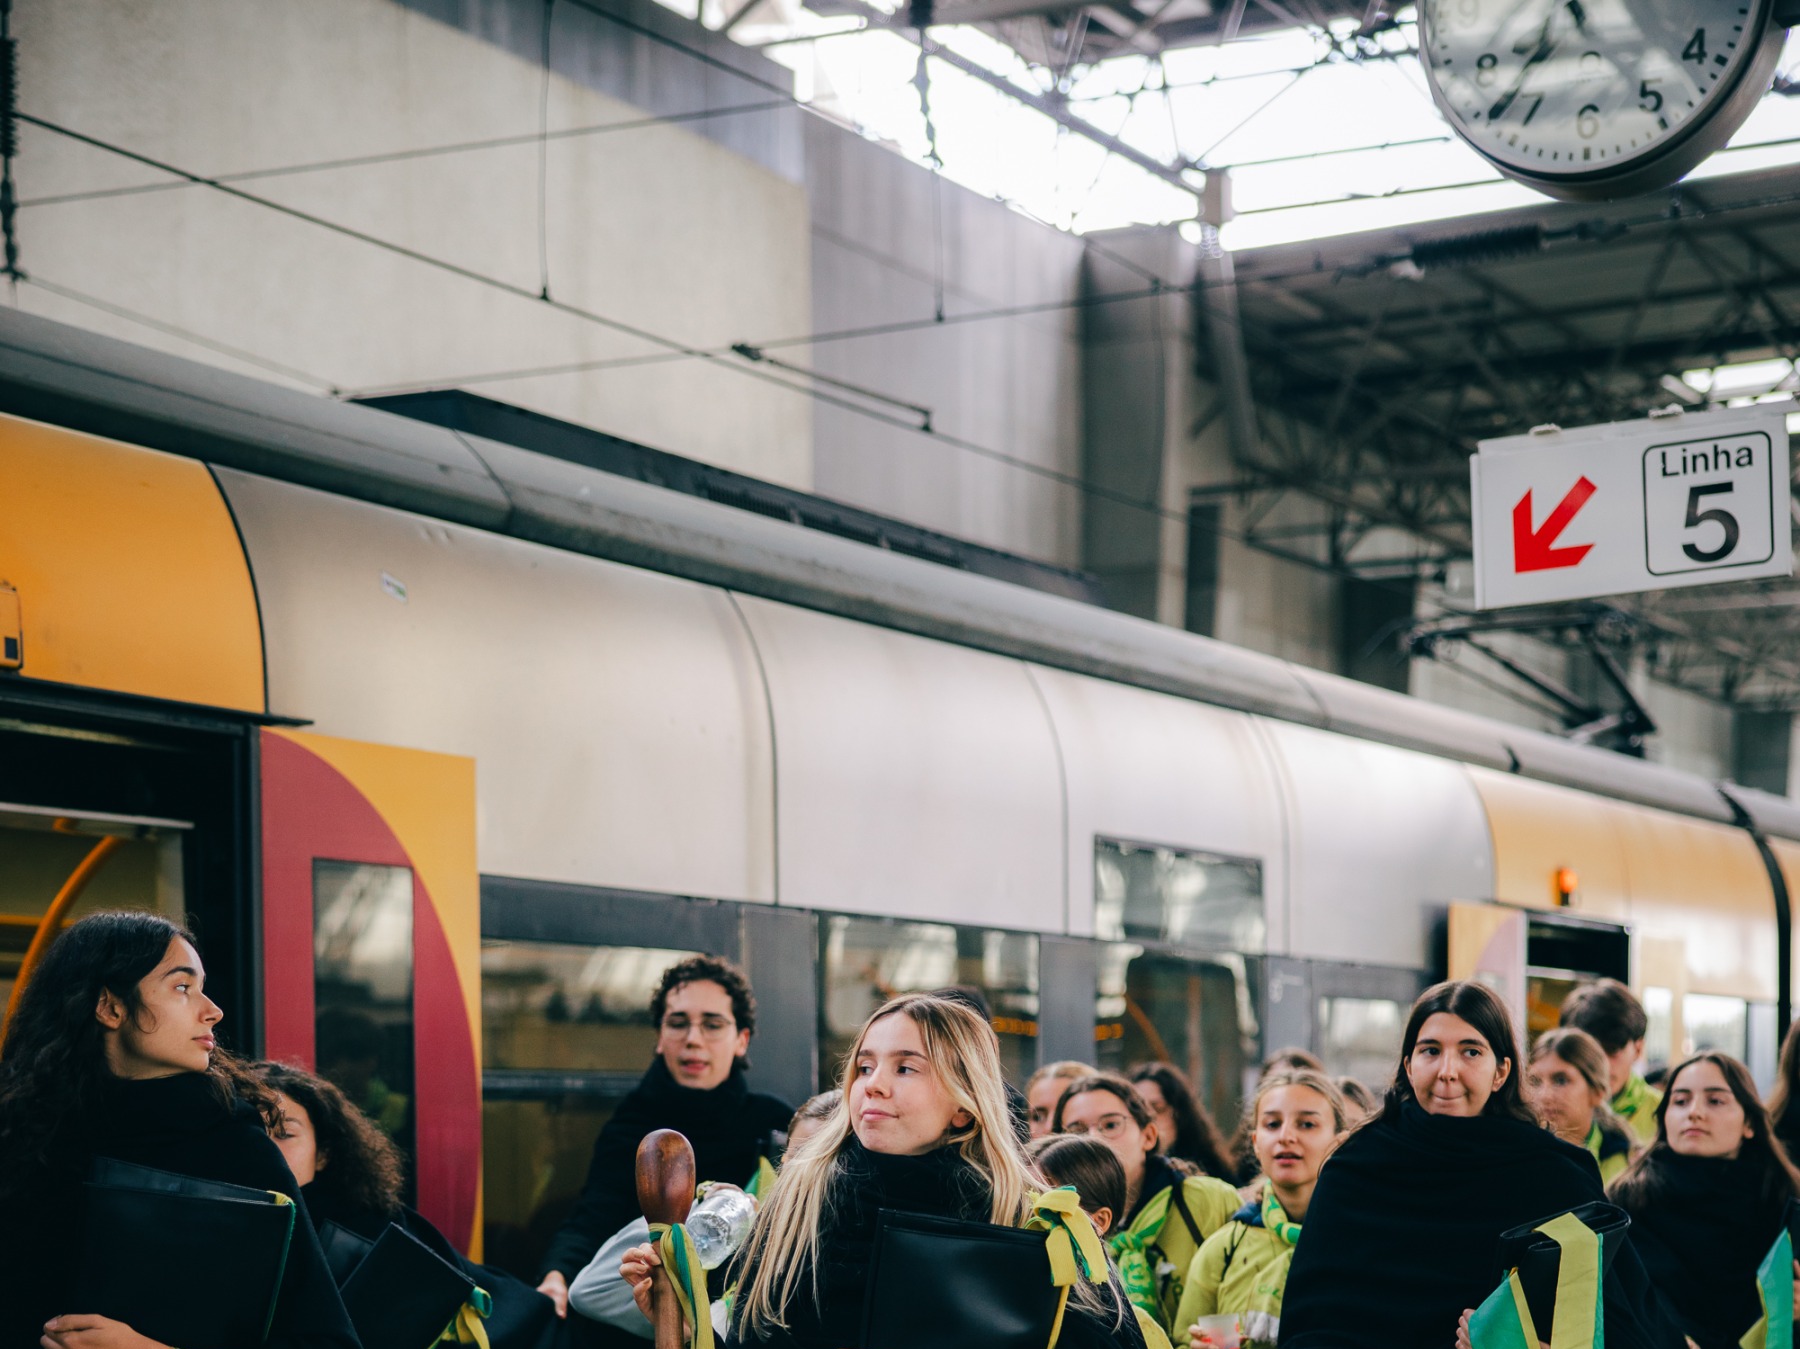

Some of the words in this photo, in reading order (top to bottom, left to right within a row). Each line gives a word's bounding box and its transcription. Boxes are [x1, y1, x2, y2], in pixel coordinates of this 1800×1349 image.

[1682, 27, 1706, 65] 4
[1476, 53, 1498, 88] 8
[1521, 92, 1544, 127] 7
[1638, 78, 1663, 113] 5
[1576, 104, 1600, 140] 6
[1661, 443, 1754, 477] Linha
[1682, 480, 1739, 562] 5
